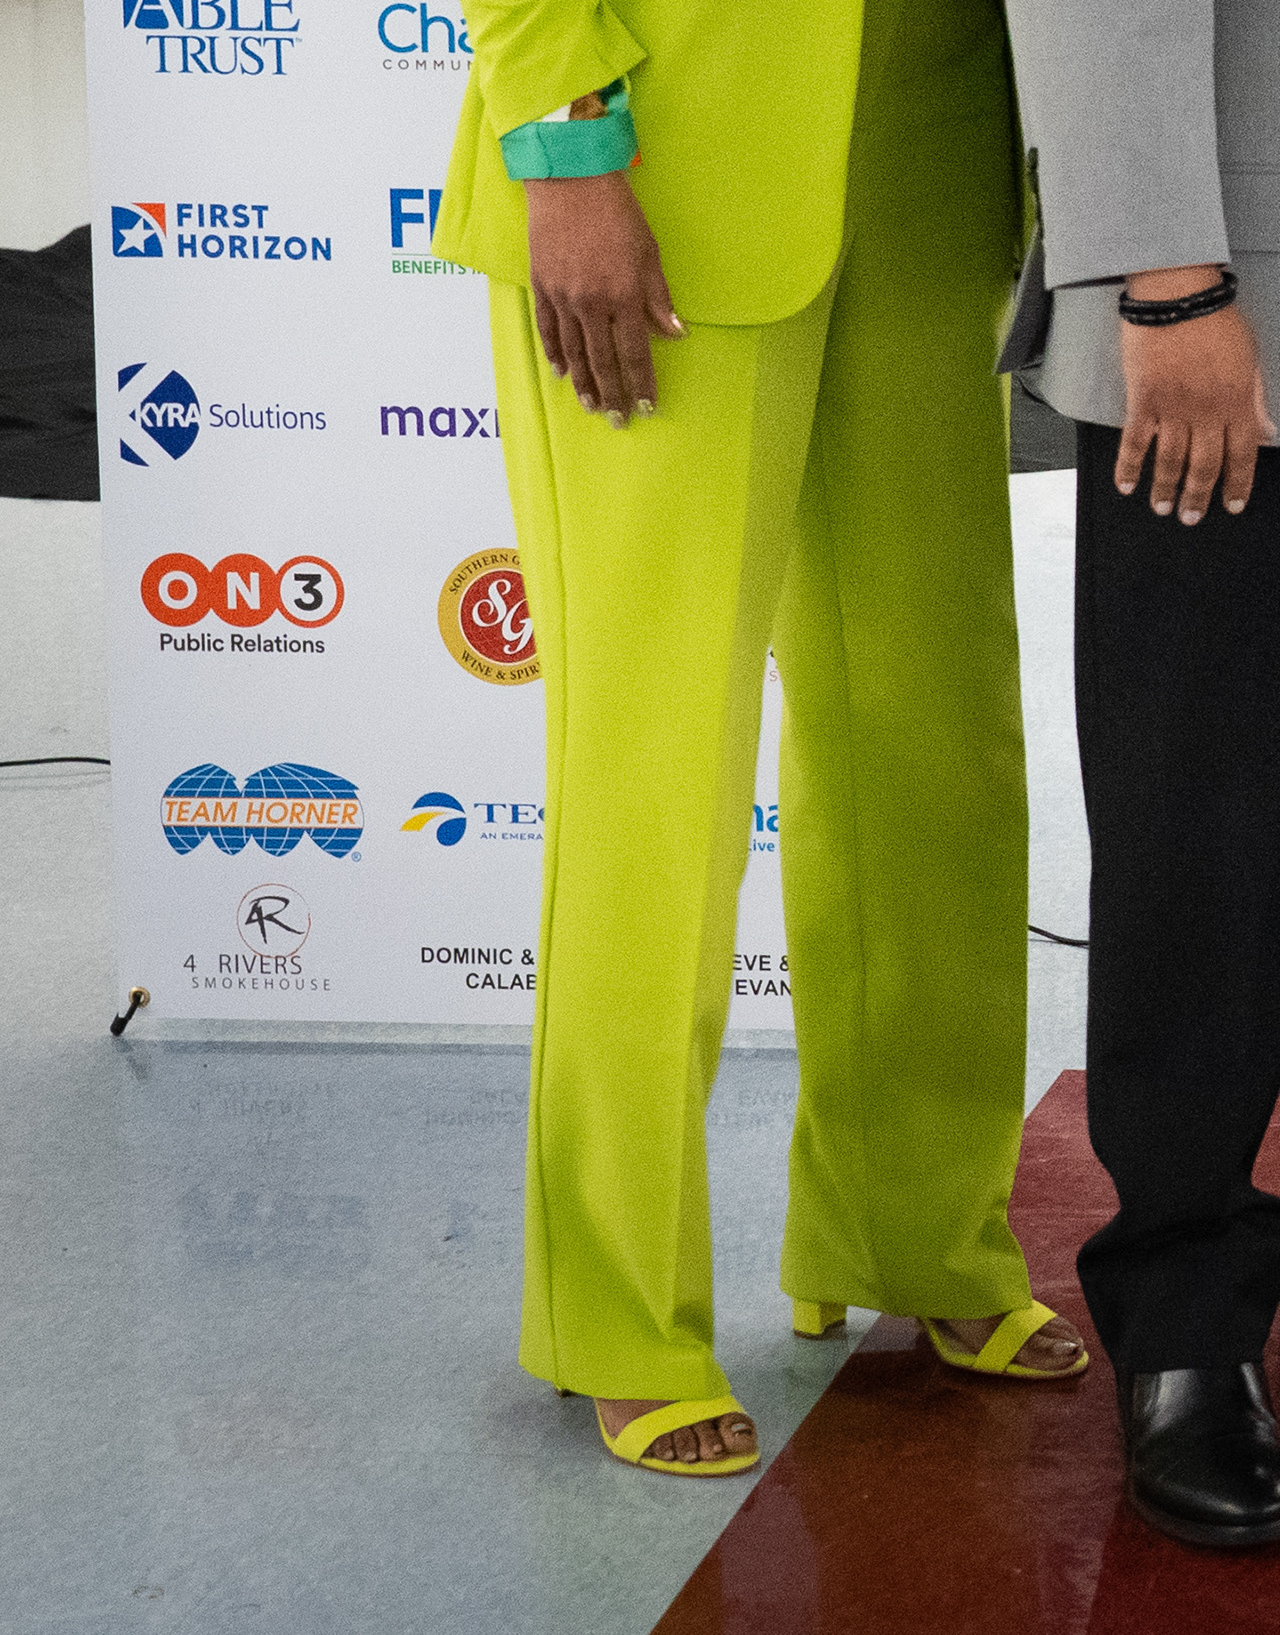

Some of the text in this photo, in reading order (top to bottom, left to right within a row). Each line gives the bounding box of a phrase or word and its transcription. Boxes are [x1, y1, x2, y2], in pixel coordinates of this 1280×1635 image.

[145, 35, 295, 76] TRUST
[176, 203, 270, 230] FIRST
[177, 234, 332, 262] HORIZON
[391, 259, 468, 275] BENEFITS
[135, 402, 327, 431] KYRA Solutions
[449, 553, 509, 595] SOUTHERN
[159, 633, 326, 655] Public Relations
[461, 650, 541, 681] WINE & SPIR
[165, 800, 358, 826] TEAM HORNER
[480, 832, 497, 841] AN
[183, 953, 302, 975] 4 RIVERS
[420, 946, 535, 966] DOMINIC &
[191, 976, 331, 991] SMOKEHOUSE
